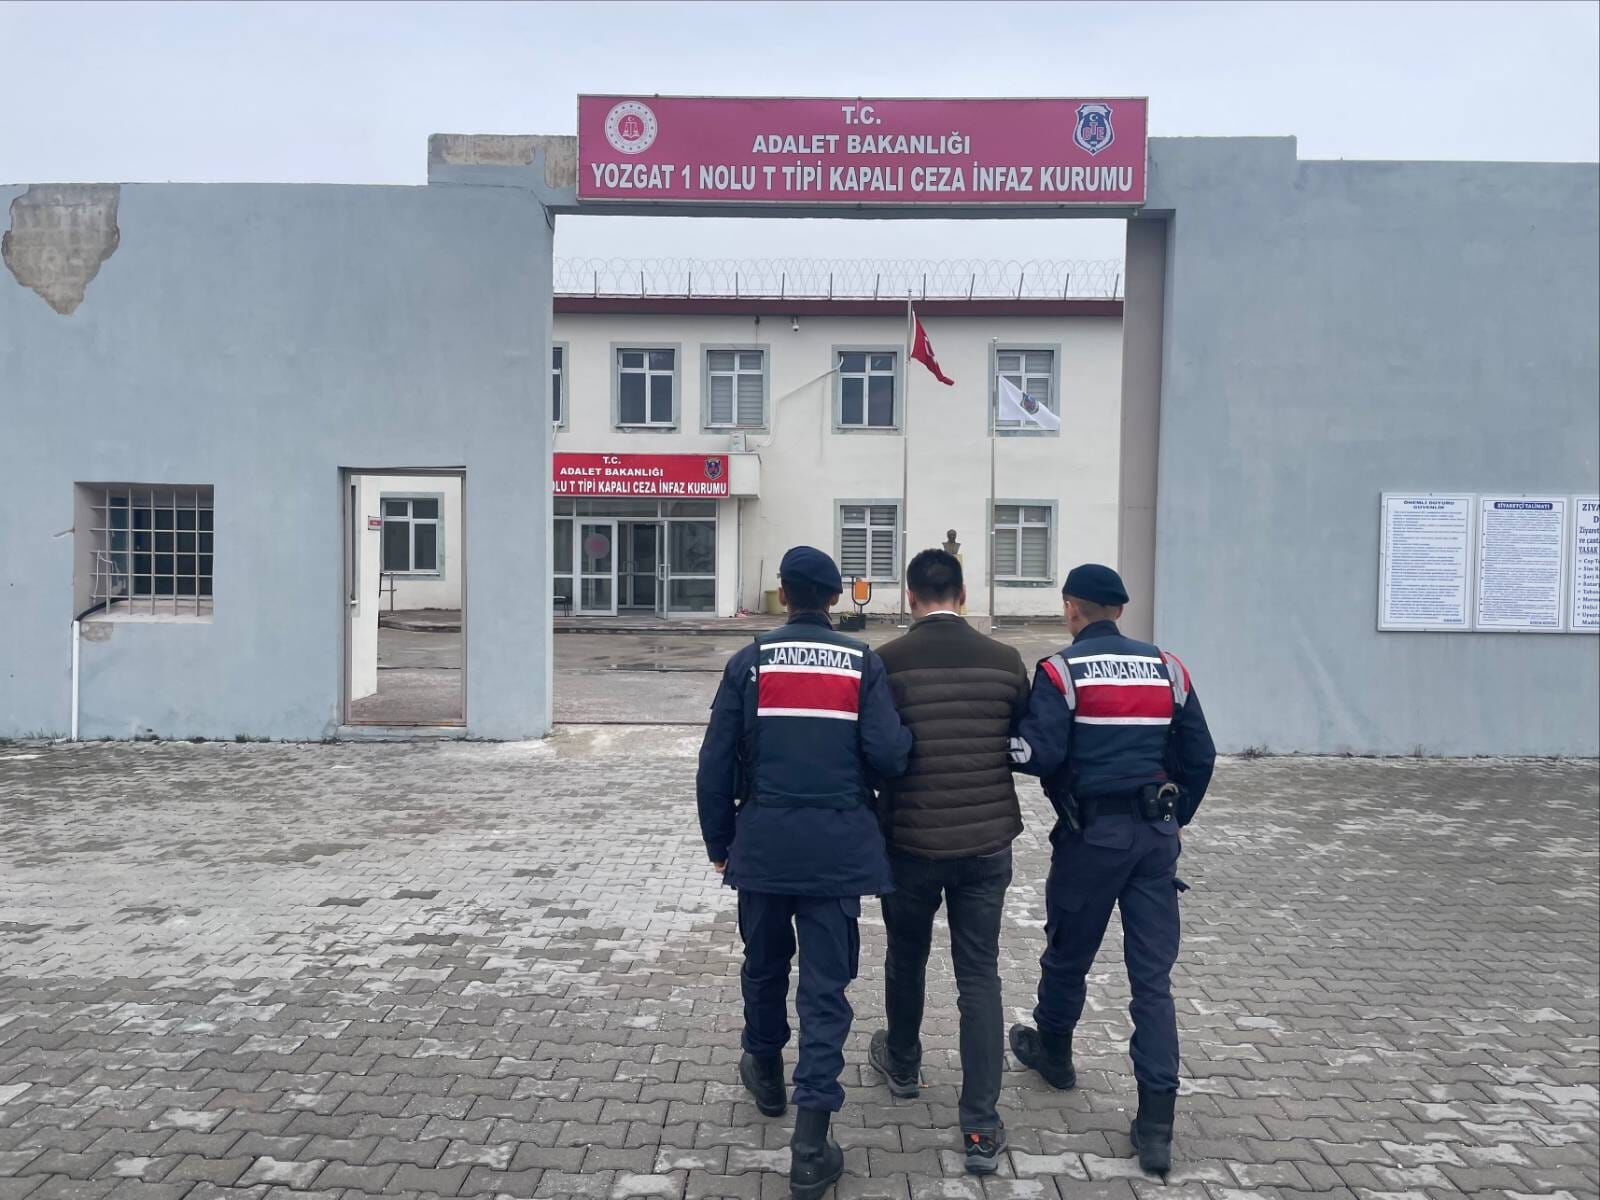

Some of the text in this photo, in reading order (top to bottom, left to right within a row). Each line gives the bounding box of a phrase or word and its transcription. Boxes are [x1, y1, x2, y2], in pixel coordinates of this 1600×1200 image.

[841, 106, 881, 125] T.C.
[752, 131, 970, 154] ADALET BAKANLIĞI
[591, 160, 1133, 192] YOZGAT 1 NOLU T TİPİ KAPALI CEZA İNFAZ KURUMU
[603, 456, 621, 465] T.C.
[560, 467, 664, 477] ADALET BAKANLIĞI
[569, 480, 576, 493] T
[578, 478, 596, 493] TİPİ
[598, 481, 631, 493] KAPALI
[633, 481, 657, 494] CEZA
[659, 479, 685, 494] İNFAZ
[688, 481, 727, 495] KURUMU
[768, 648, 852, 669] JANDARMA
[1083, 660, 1161, 680] JANDARMA
